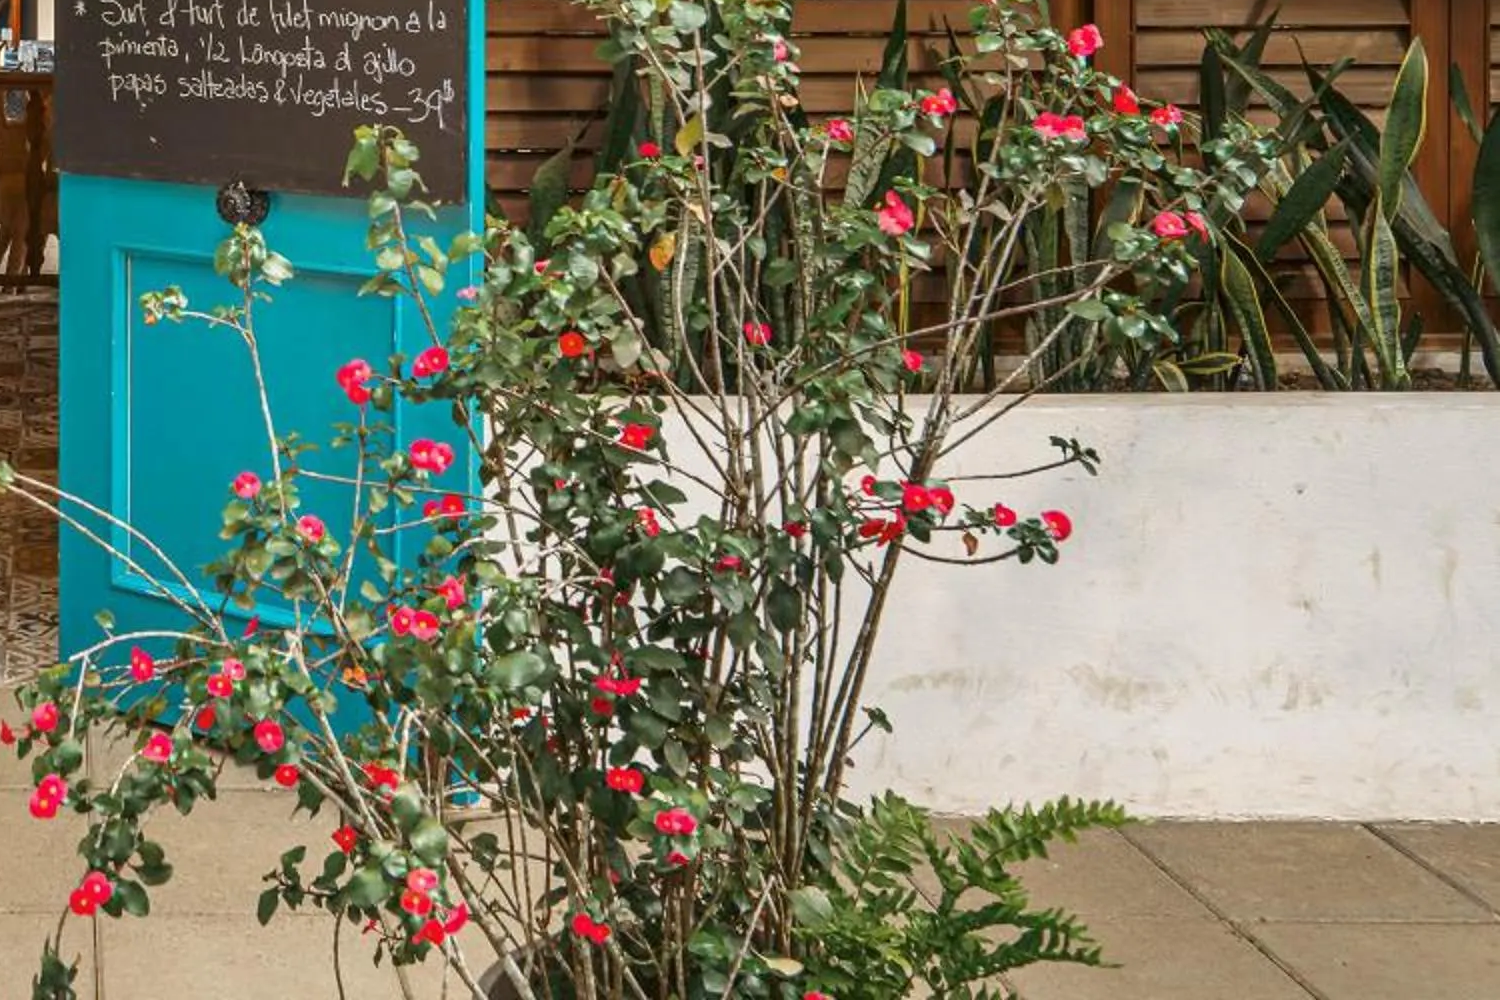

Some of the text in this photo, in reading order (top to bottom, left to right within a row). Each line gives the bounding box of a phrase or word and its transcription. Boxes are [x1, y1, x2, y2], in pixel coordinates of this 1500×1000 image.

[318, 6, 400, 42] mignon
[405, 9, 421, 34] a
[334, 41, 353, 72] al
[108, 72, 168, 102] papas
[177, 68, 270, 104] salteadas
